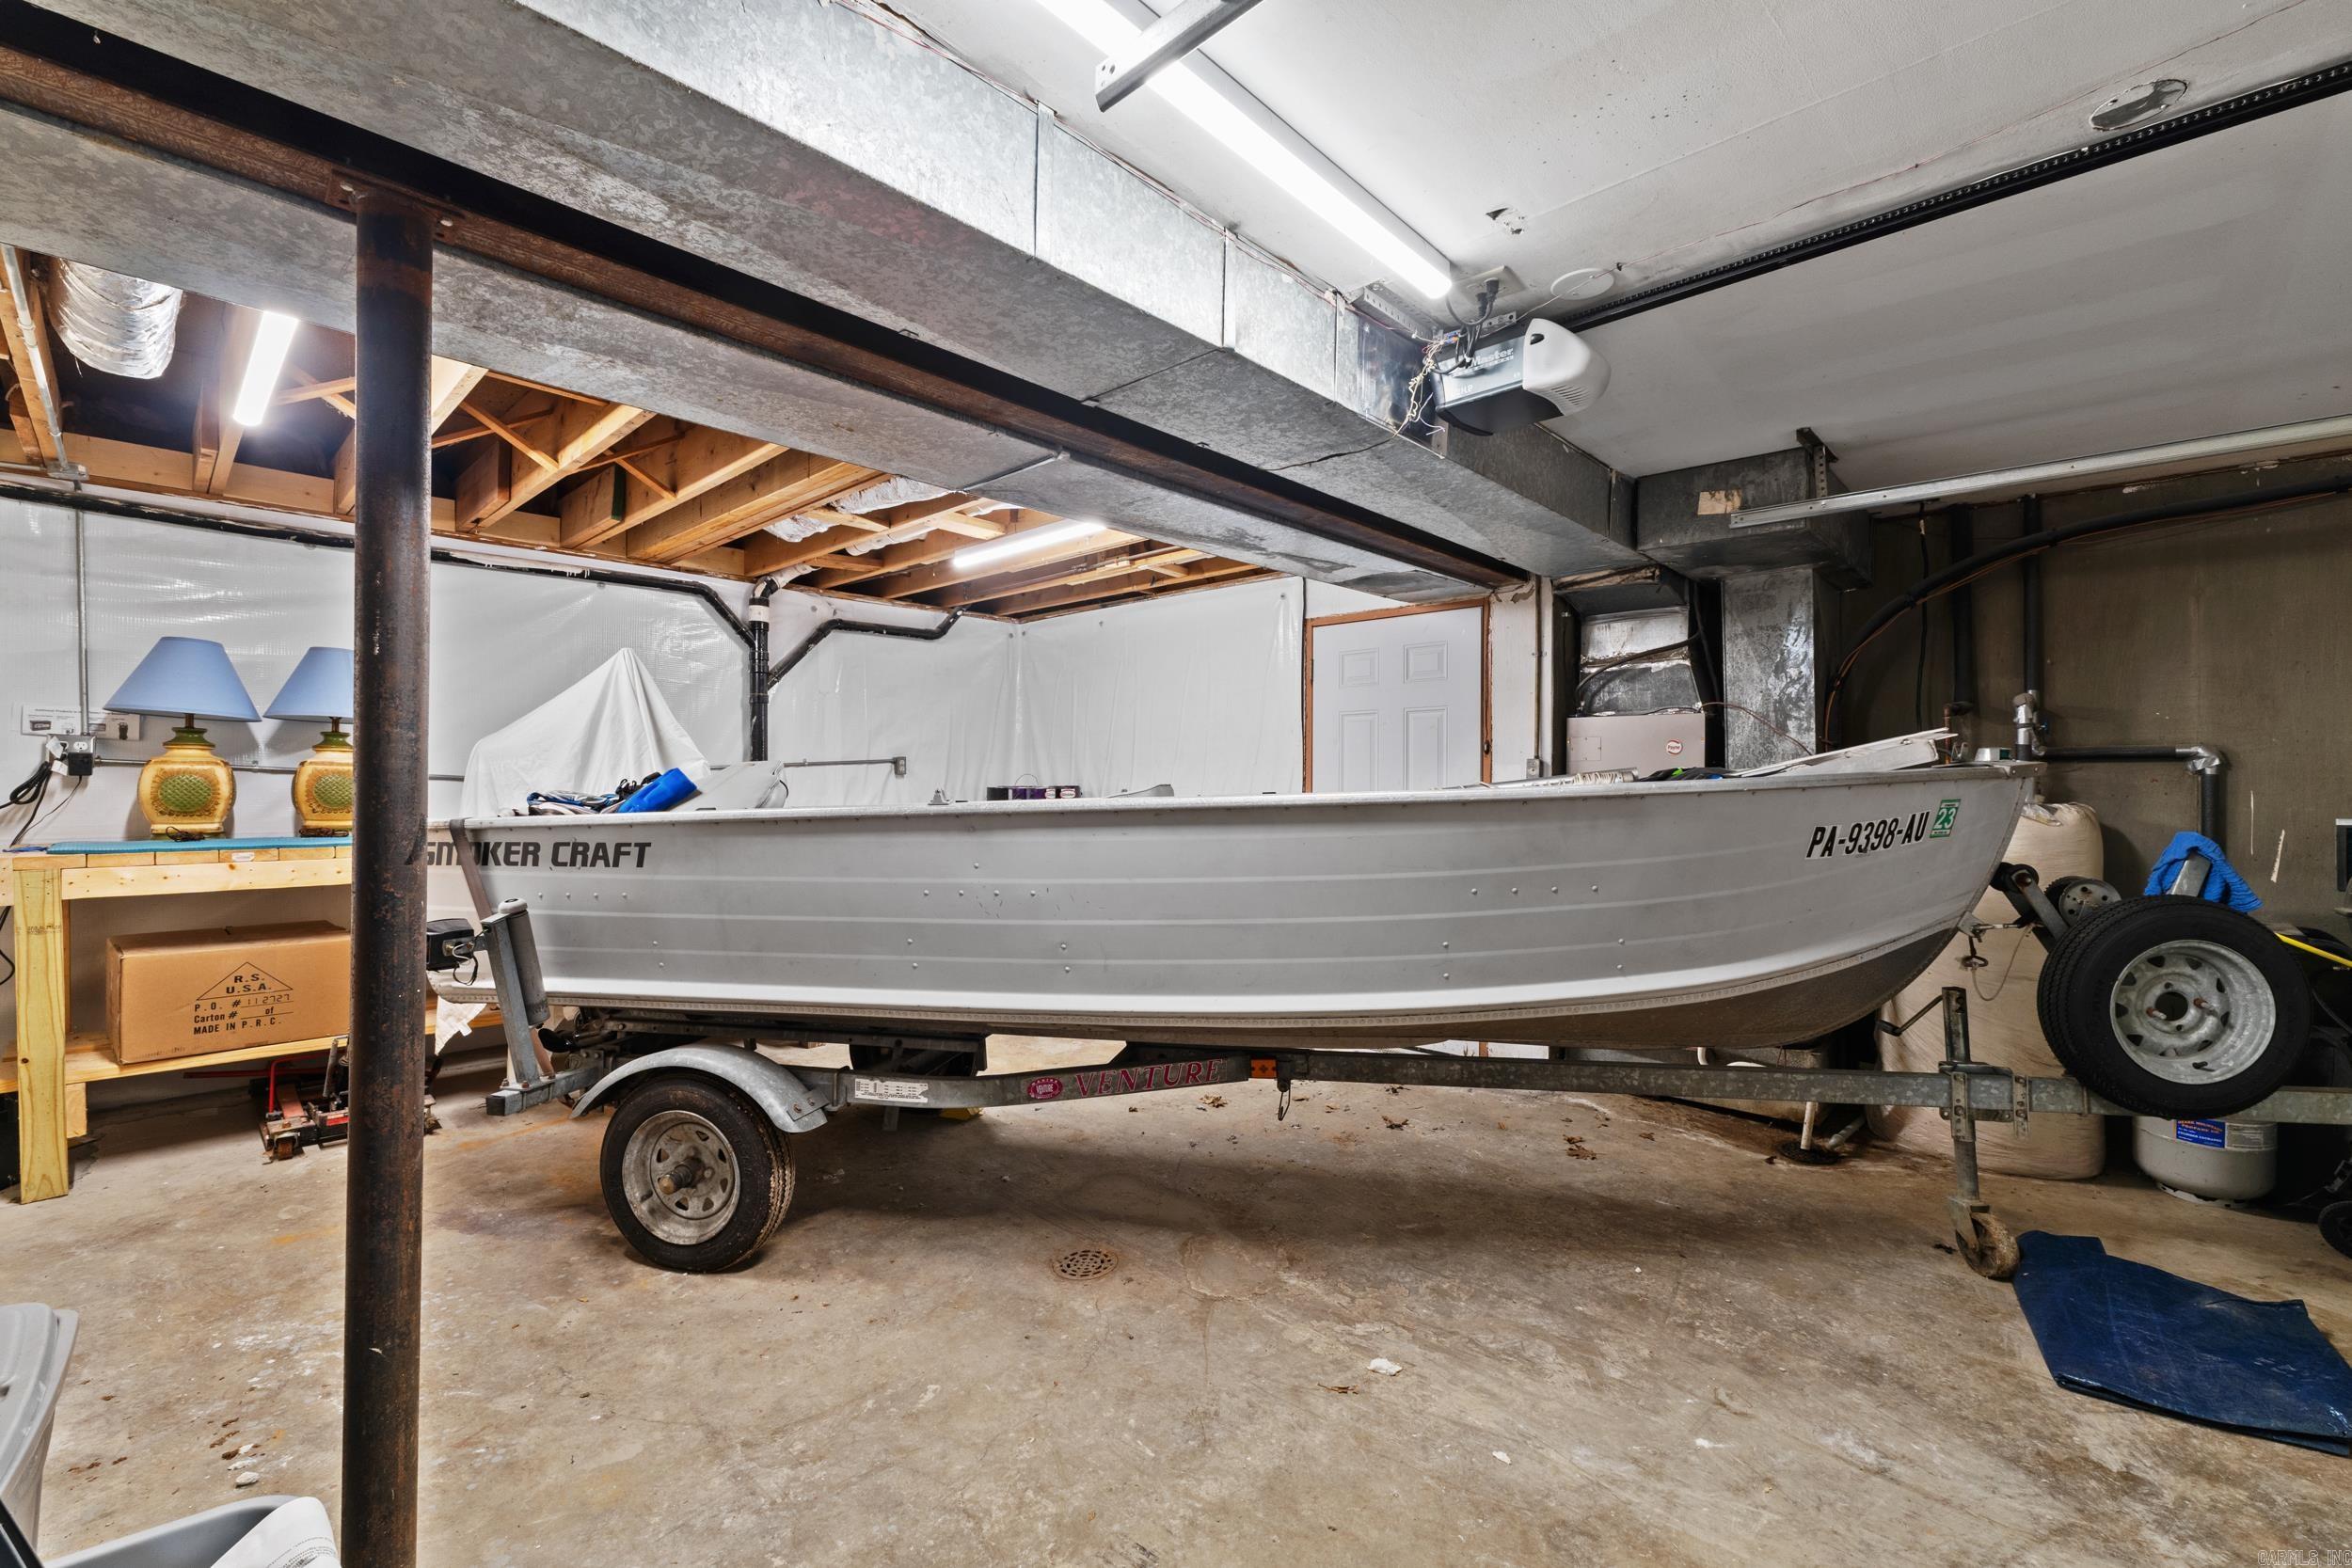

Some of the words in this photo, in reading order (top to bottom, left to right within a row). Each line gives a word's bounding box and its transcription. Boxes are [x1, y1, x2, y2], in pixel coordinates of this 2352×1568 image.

[1933, 808, 1957, 830] 23
[1805, 811, 1931, 858] PA-9398-AU
[550, 841, 652, 868] CRAFT
[226, 983, 272, 994] U.S.A.
[194, 1013, 226, 1024] Carton
[228, 1010, 238, 1020] #
[264, 1006, 275, 1015] of
[193, 1023, 220, 1036] MADE
[226, 1022, 236, 1031] IN
[1075, 1058, 1223, 1098] VENTURE
